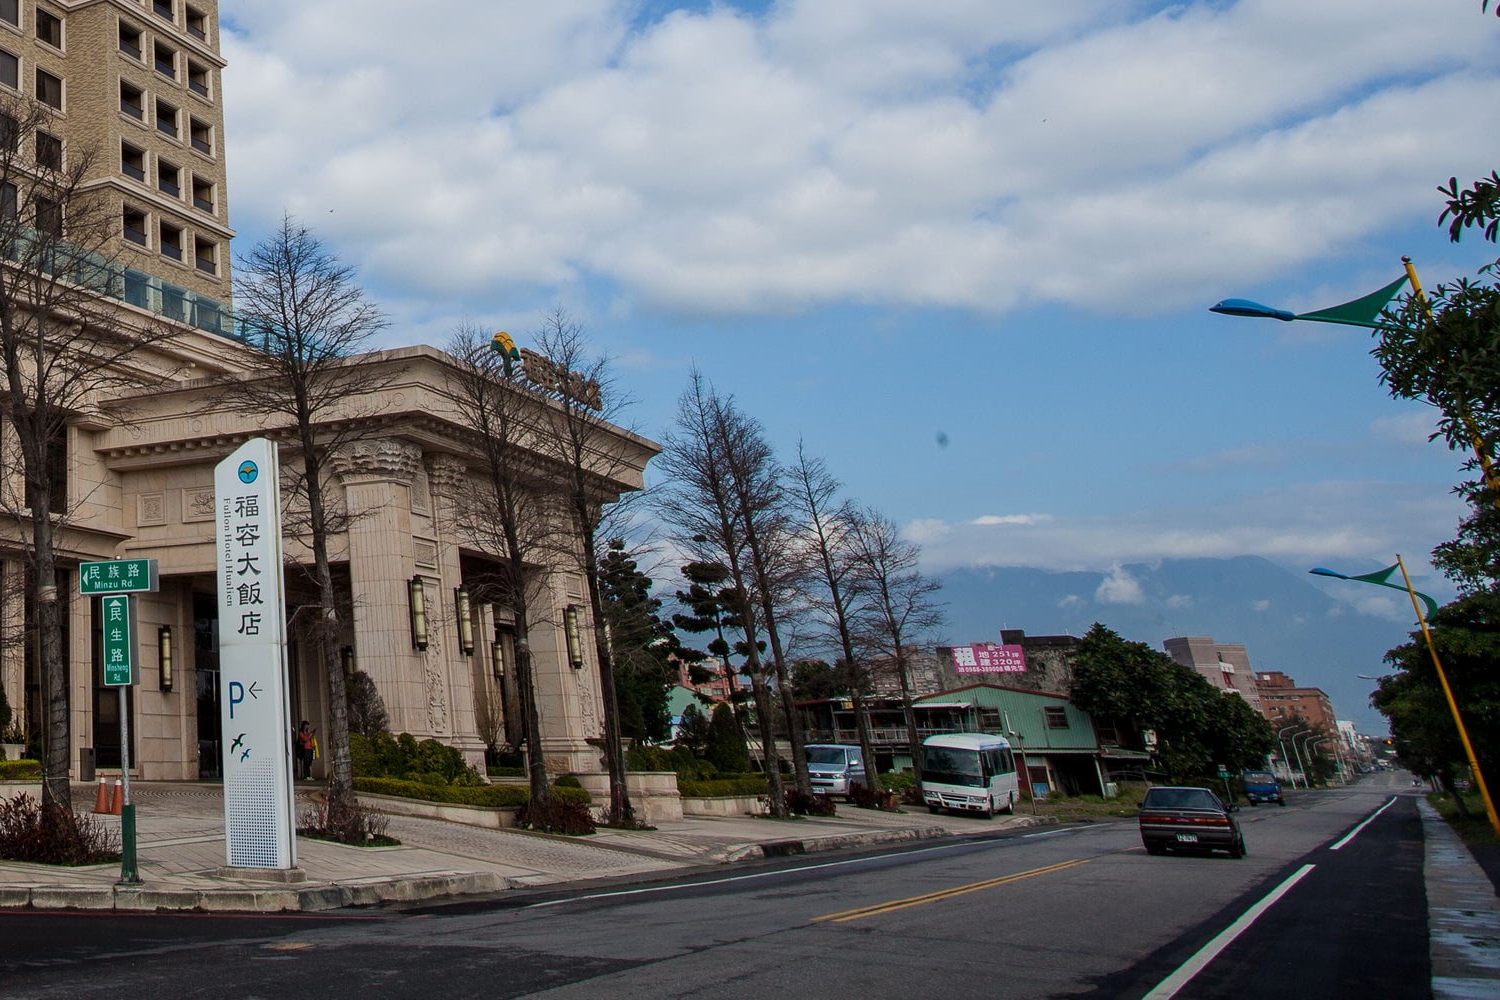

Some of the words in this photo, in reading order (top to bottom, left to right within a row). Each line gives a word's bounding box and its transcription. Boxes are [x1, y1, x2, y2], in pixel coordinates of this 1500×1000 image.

[223, 498, 232, 531] Fullon
[224, 534, 233, 562] Hotel
[89, 563, 140, 580] 民族路
[234, 494, 264, 636] 福容大飯店
[94, 581, 119, 589] Minzu
[121, 579, 135, 588] Rd.
[225, 565, 235, 607] Hualien
[110, 607, 123, 662] 民生路
[953, 647, 977, 667] 租
[229, 681, 244, 719] P
